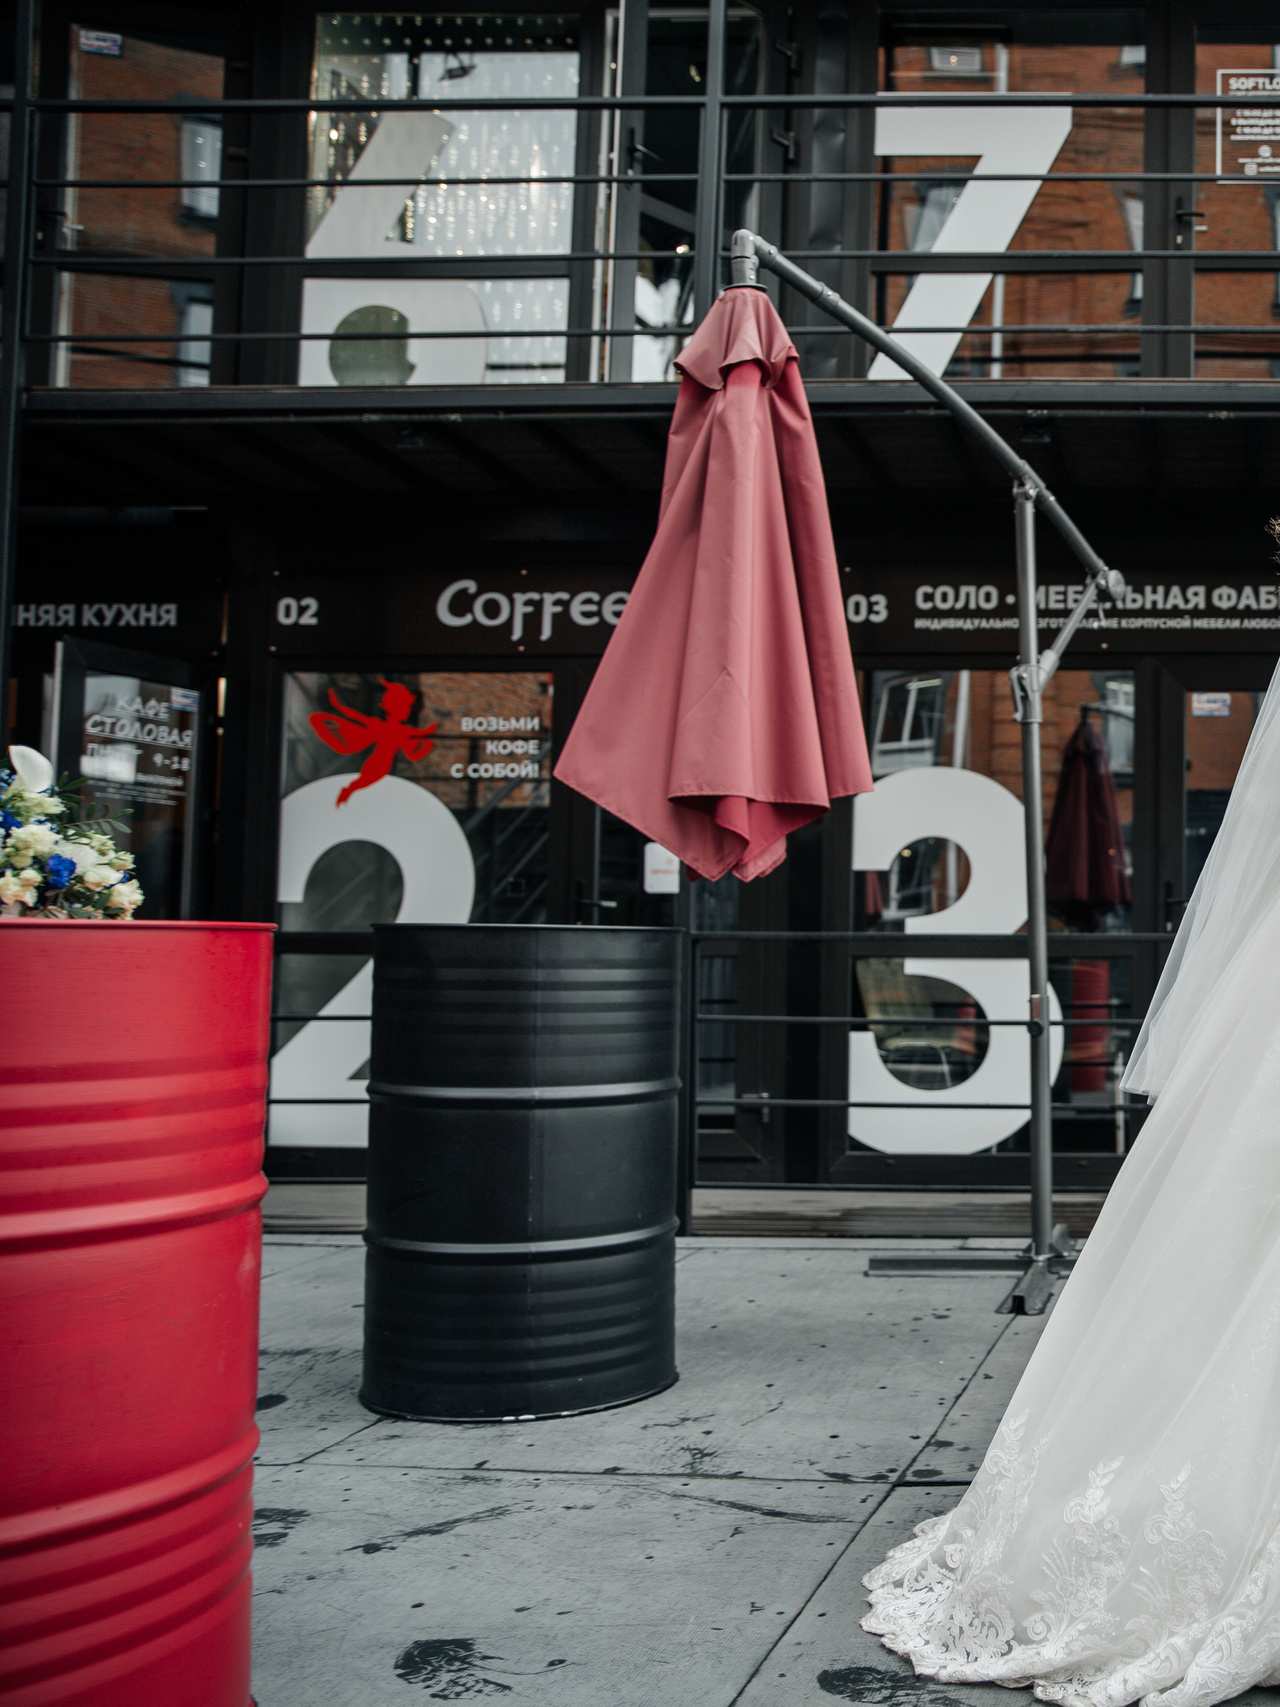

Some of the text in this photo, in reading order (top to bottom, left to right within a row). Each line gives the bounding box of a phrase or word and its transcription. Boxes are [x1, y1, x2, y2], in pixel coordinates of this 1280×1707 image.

[868, 91, 1073, 381] 7
[276, 597, 319, 626] 02
[847, 594, 889, 624] 03
[915, 584, 999, 611] СОЛО
[12, 604, 178, 627] НЯЯ КУХНЯ
[1121, 615, 1191, 630] КОРПУСНОЙ
[1193, 617, 1241, 630] МЕБЕЛИ
[85, 714, 194, 747] СТОЛОВАЯ
[461, 716, 540, 732] ВОЗЬМИ
[486, 739, 540, 755] КОФЕ
[450, 759, 540, 778] С СОБОЙ!
[270, 772, 476, 1148] 2
[847, 766, 1065, 1156] 3
